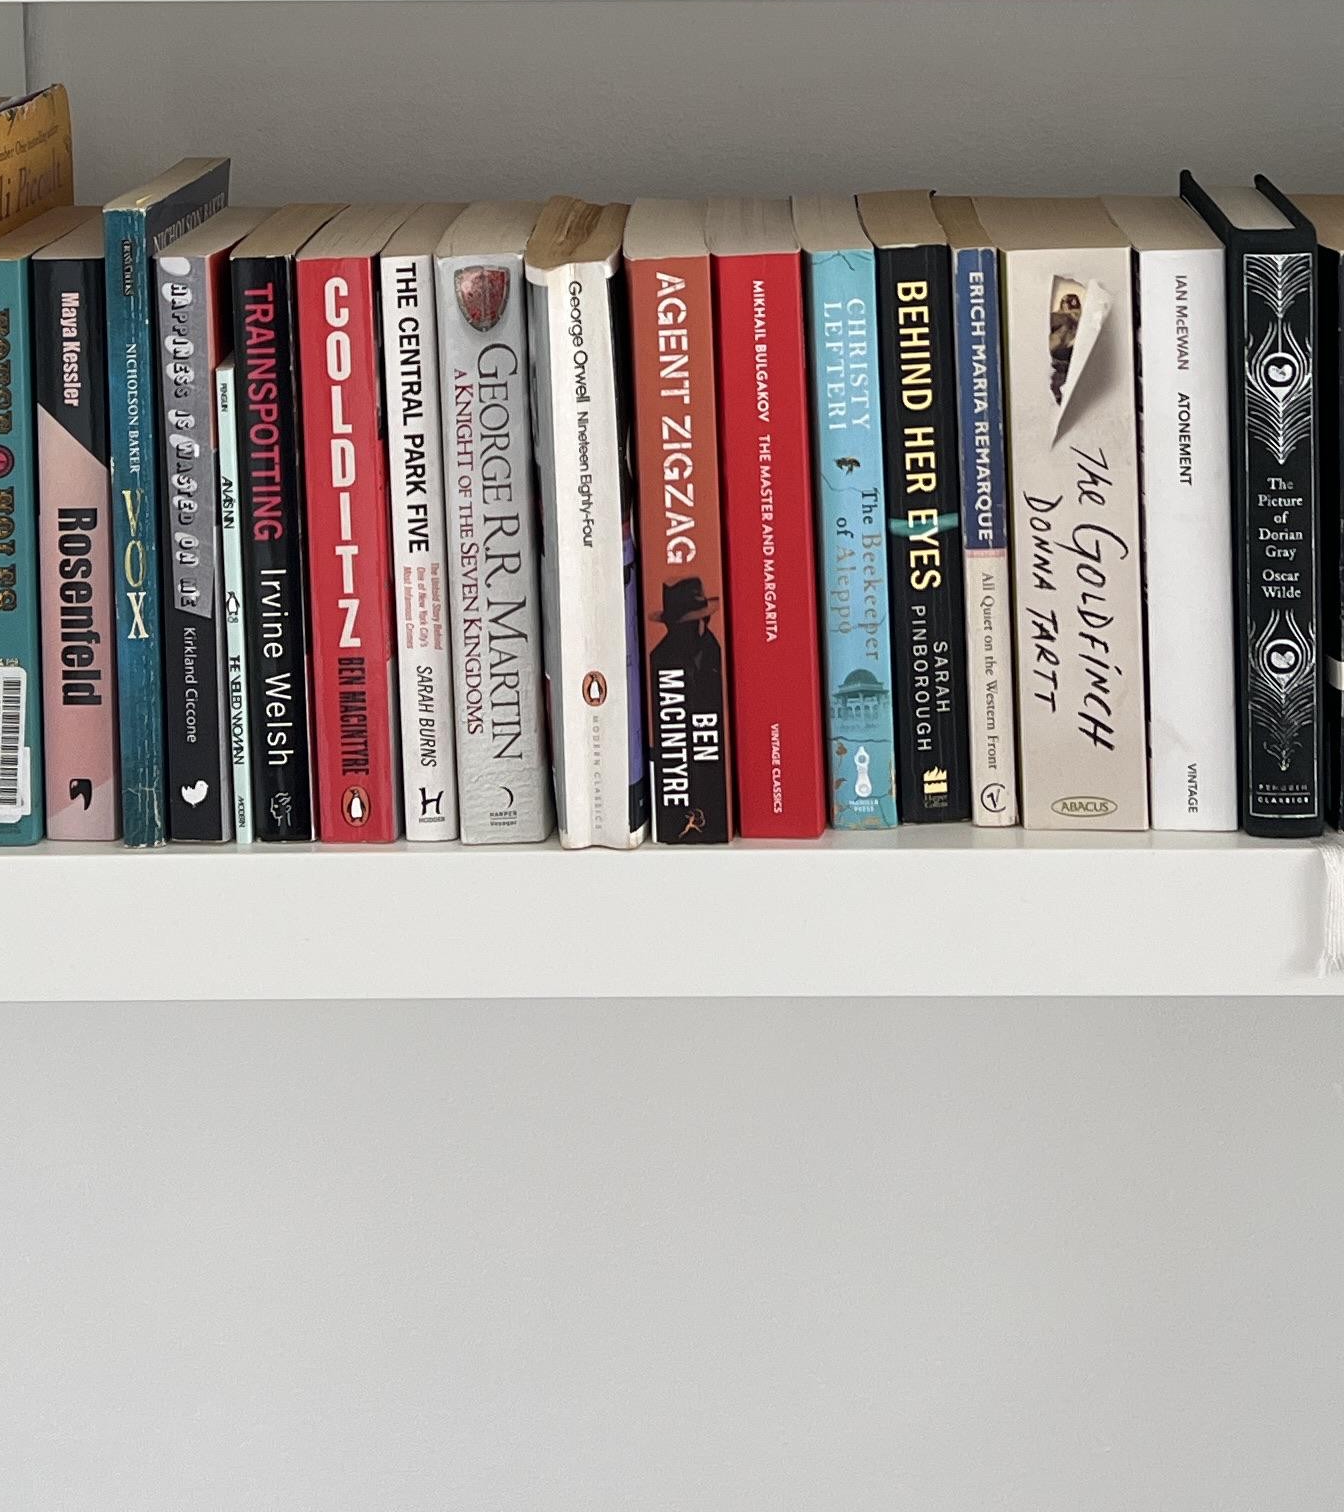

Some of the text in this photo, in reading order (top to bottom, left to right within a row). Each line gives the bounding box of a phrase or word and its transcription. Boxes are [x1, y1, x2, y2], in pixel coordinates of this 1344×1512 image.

[61, 293, 81, 407] Maya Kessler
[566, 281, 590, 403] George Orwell
[244, 282, 284, 542] TRAINSPOTTING
[394, 263, 431, 554] THE CENTRAL PARK FIVE
[896, 281, 940, 590] BEHIND HER EYES
[1177, 392, 1193, 486] ATONEMENT
[324, 277, 362, 649] COLDITZ
[1267, 478, 1294, 490] The
[1258, 495, 1303, 507] Picture
[1259, 528, 1303, 541] Dorian
[1274, 512, 1288, 524] of
[1262, 570, 1299, 582] Oscar
[1266, 546, 1296, 560] Gray
[57, 507, 102, 707] Rosenfeld
[1262, 586, 1302, 599] Wilde
[912, 606, 930, 751] PINBOROUGH
[1061, 801, 1108, 813] ABACUS
[1187, 764, 1198, 814] VINTAGE
